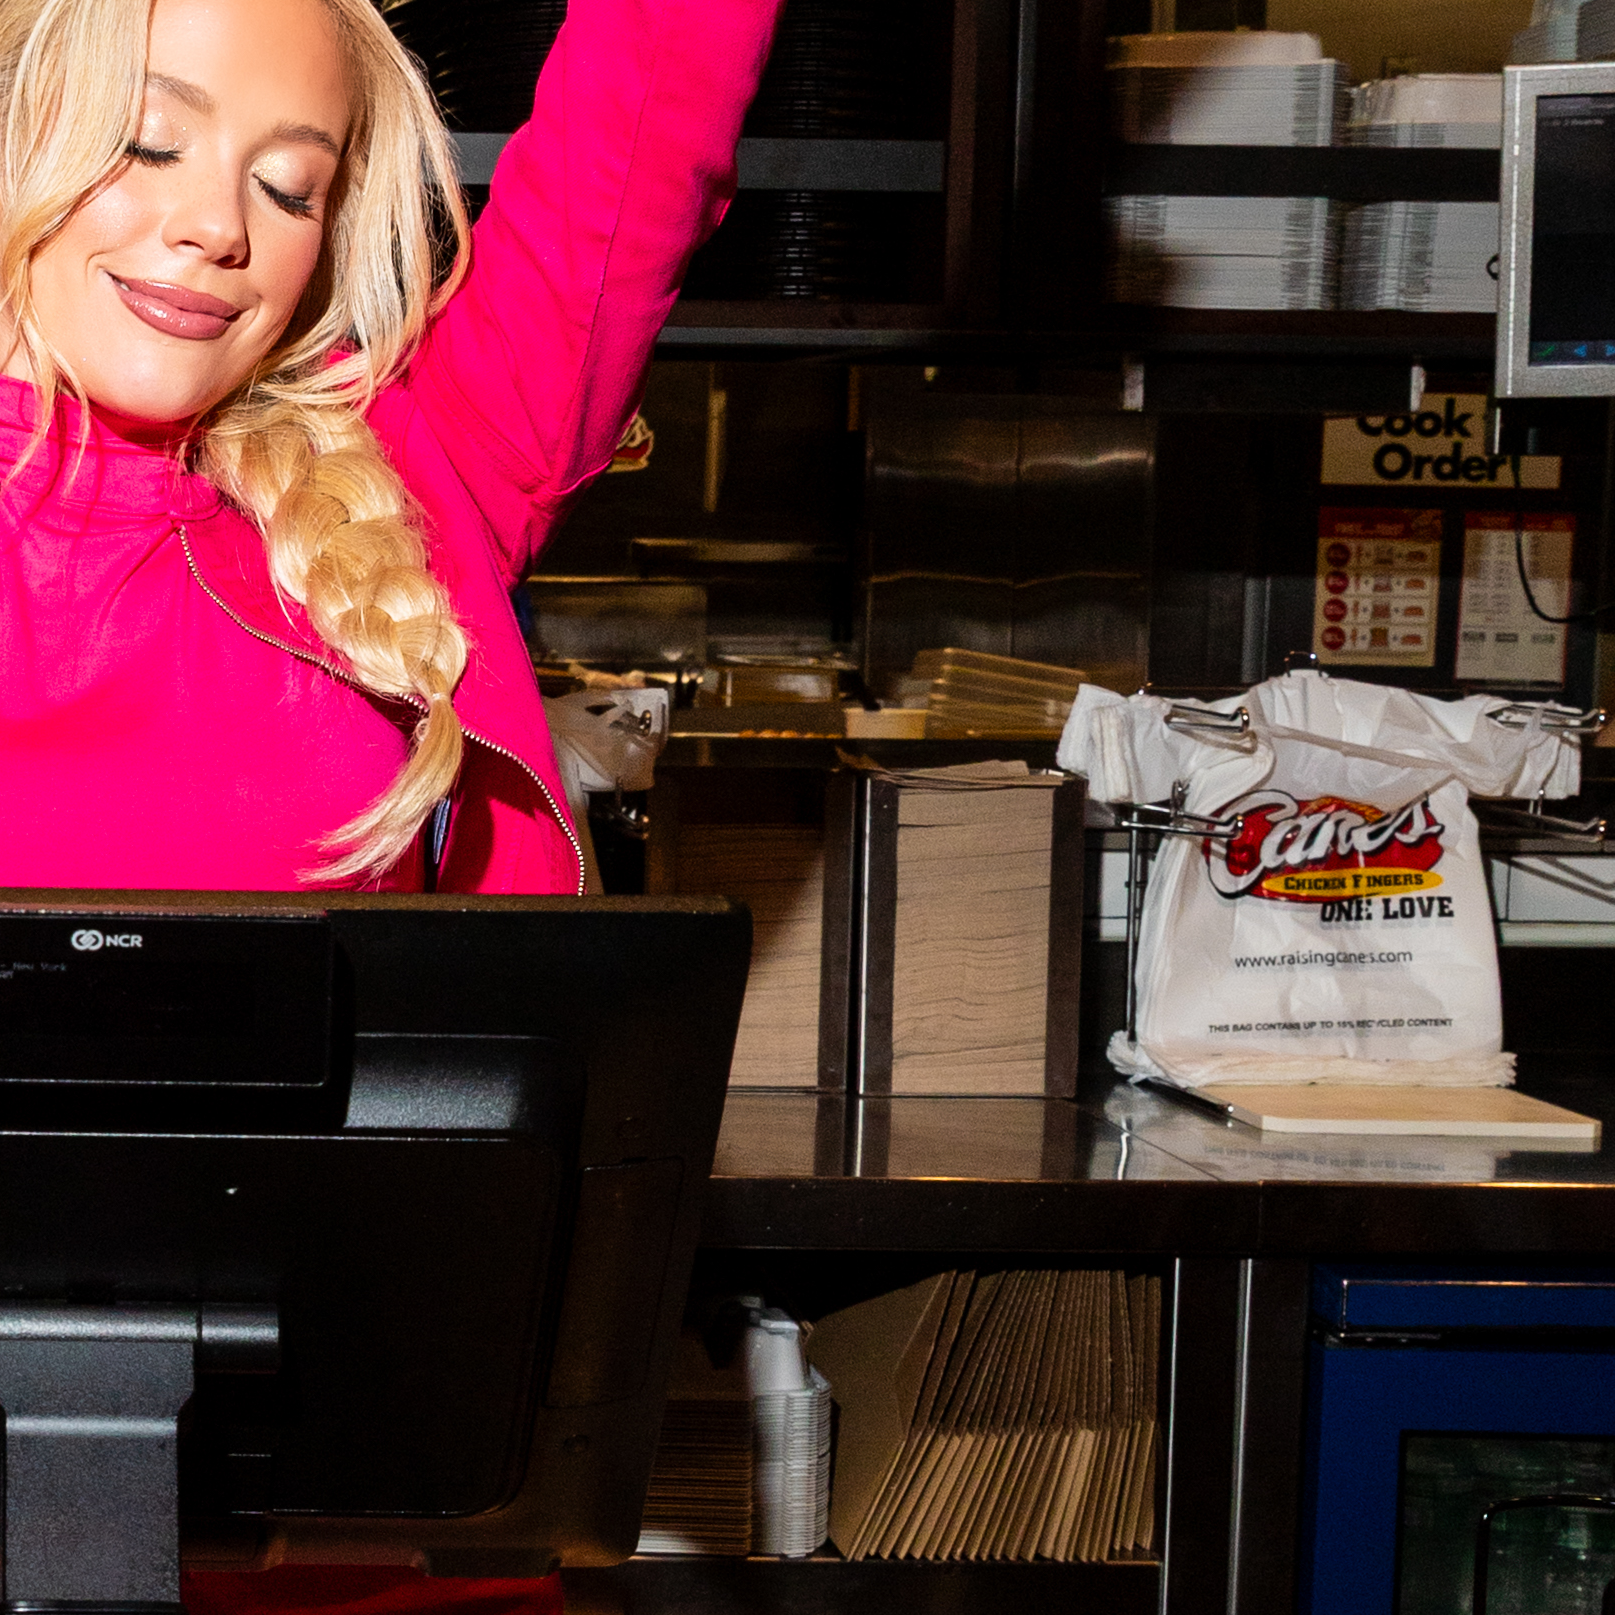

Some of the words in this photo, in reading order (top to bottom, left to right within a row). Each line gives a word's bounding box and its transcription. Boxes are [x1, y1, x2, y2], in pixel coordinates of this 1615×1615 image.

[1373, 442, 1507, 482] Order
[1321, 899, 1373, 922] ONE
[1382, 896, 1454, 920] LOVE
[105, 934, 143, 948] NCR
[1234, 950, 1413, 968] www.raisingcanes.com
[1208, 1024, 1230, 1033] THIS
[1232, 1023, 1253, 1032] BAG
[1303, 1021, 1317, 1030] UP
[1321, 1020, 1334, 1029] TO
[1407, 1018, 1454, 1028] CONTENT
